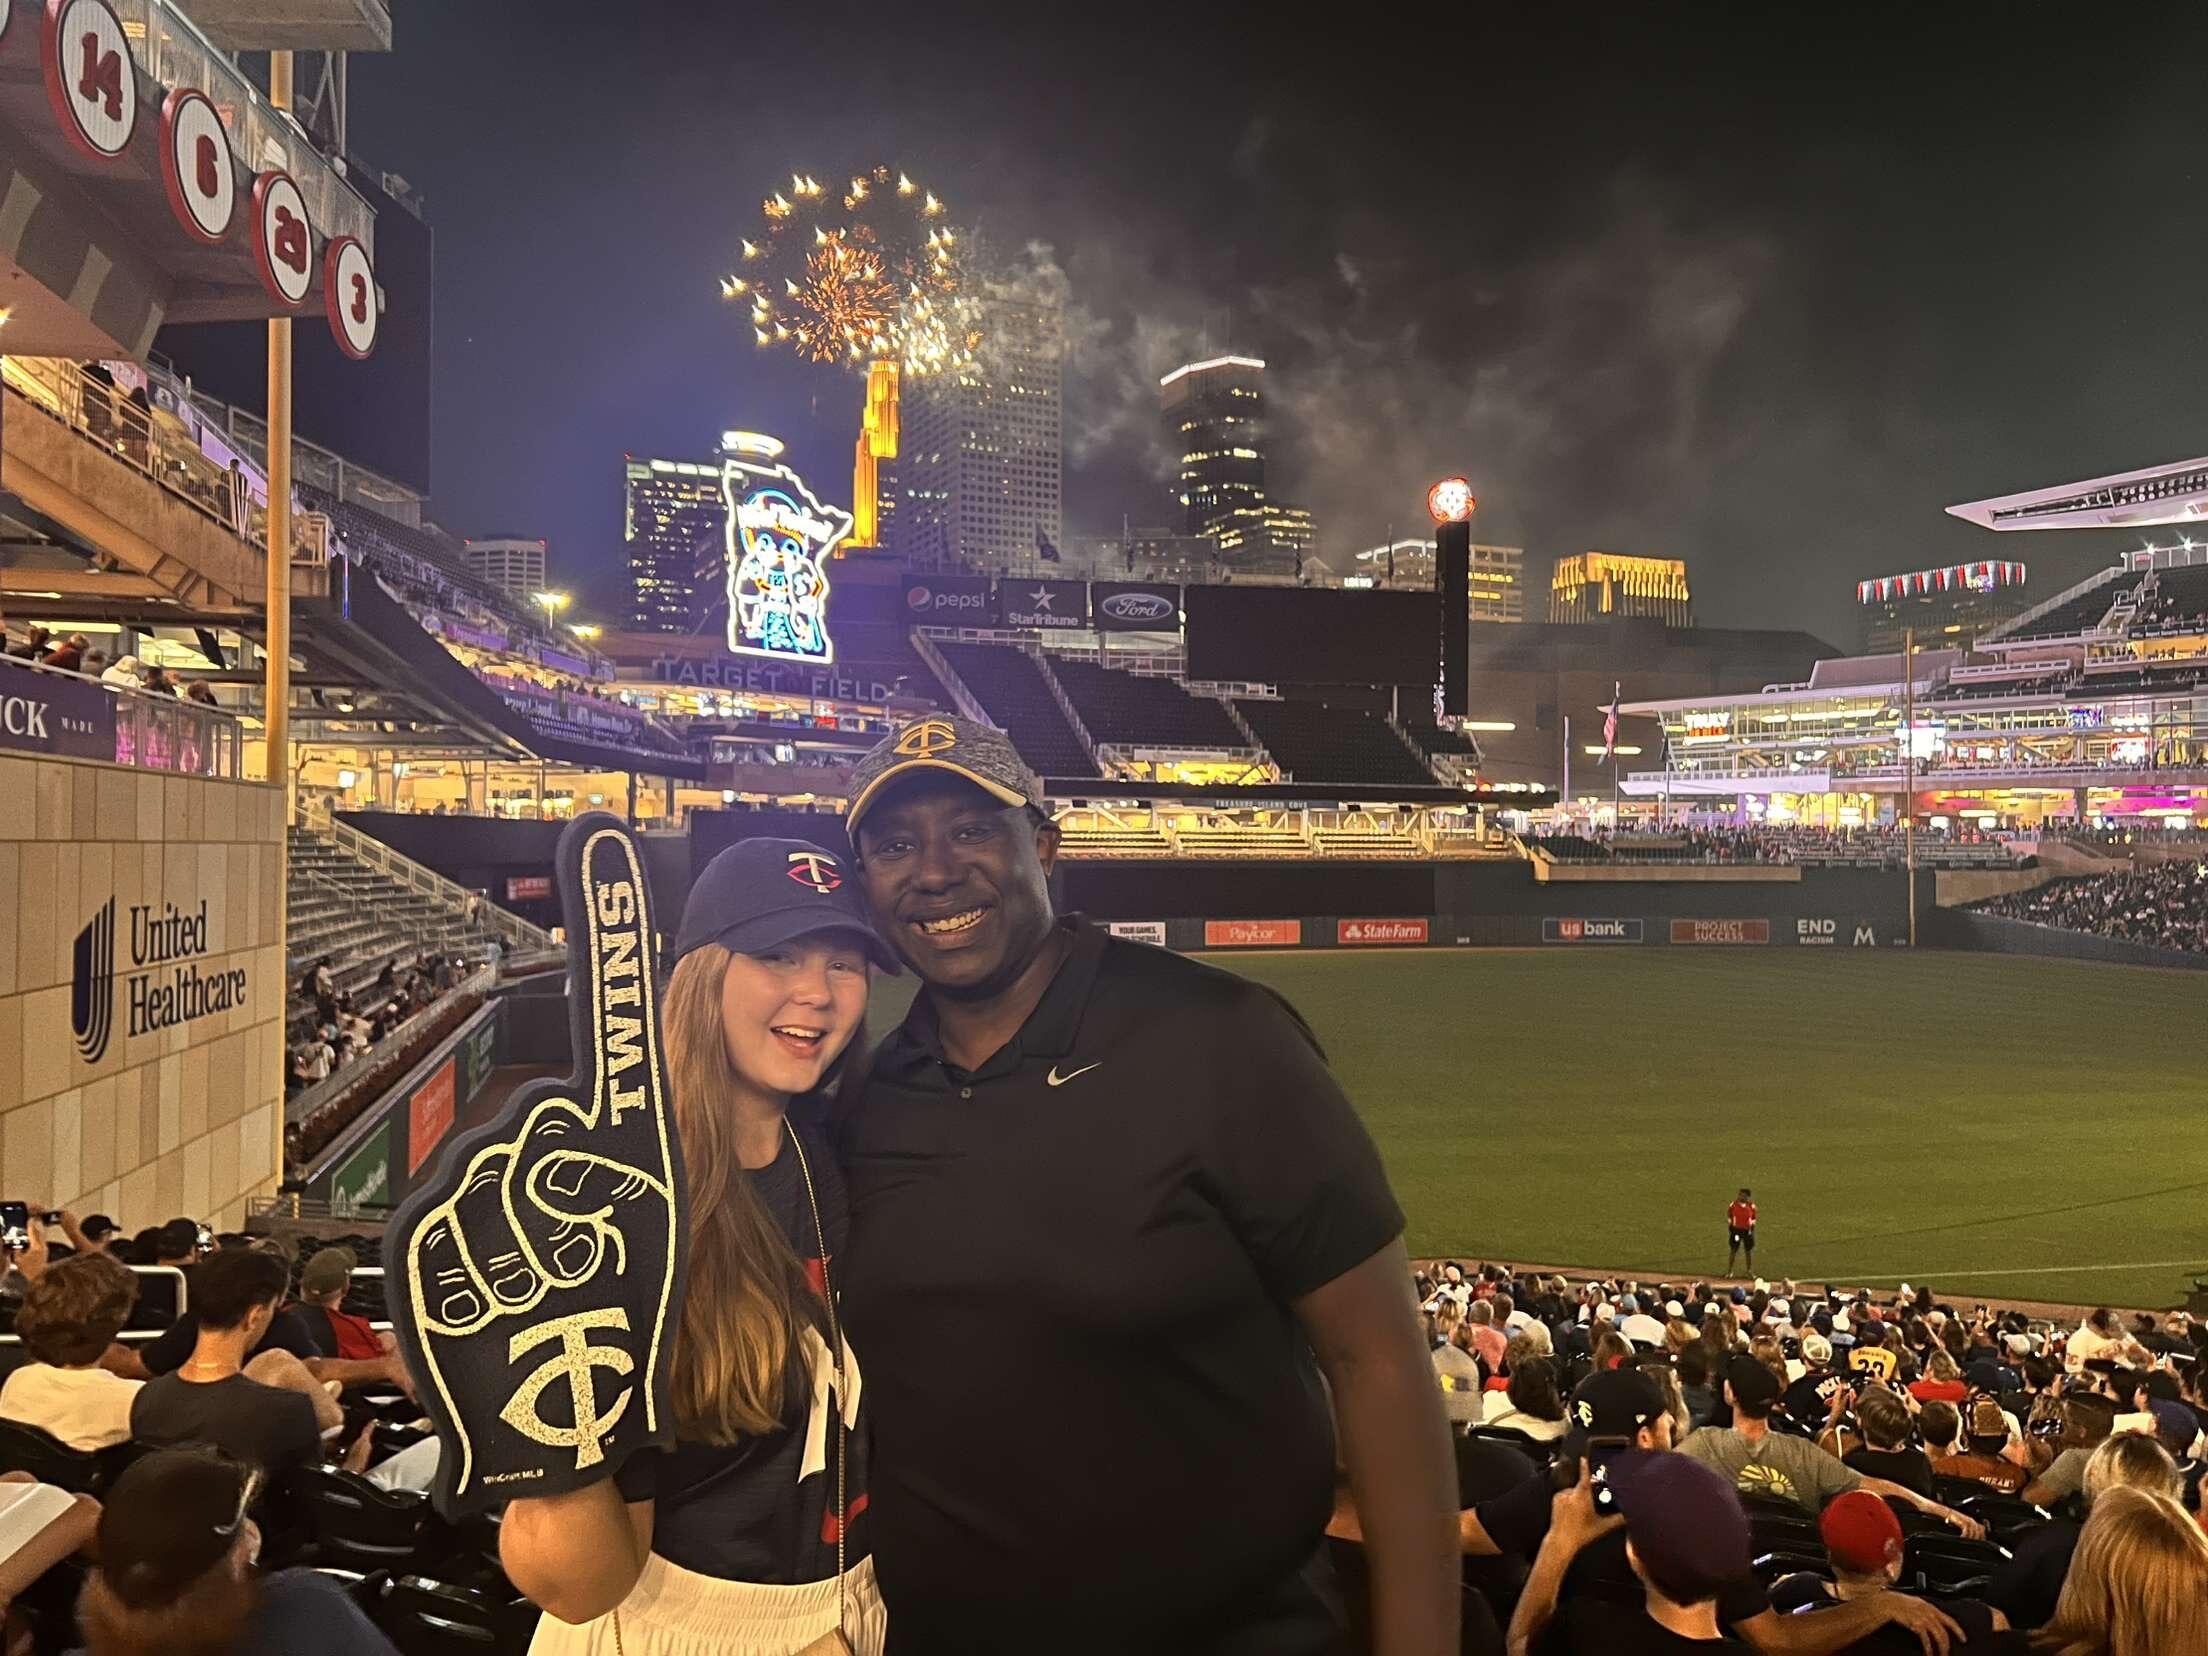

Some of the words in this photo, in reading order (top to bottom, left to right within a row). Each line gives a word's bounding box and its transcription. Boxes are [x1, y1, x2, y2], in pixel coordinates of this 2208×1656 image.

[79, 32, 122, 121] 14
[196, 134, 217, 198] 6
[351, 272, 367, 324] 3
[935, 592, 984, 609] pepsi
[1114, 595, 1160, 617] Ford
[661, 659, 784, 692] TARGET
[811, 676, 888, 702] FIELD
[0, 694, 48, 739] CK
[129, 900, 207, 966] United
[1229, 928, 1276, 942] Paycor
[1797, 919, 1836, 934] END
[1799, 936, 1834, 945] RACISM
[128, 964, 246, 1037] Healthcare
[597, 881, 646, 1126] TWINS
